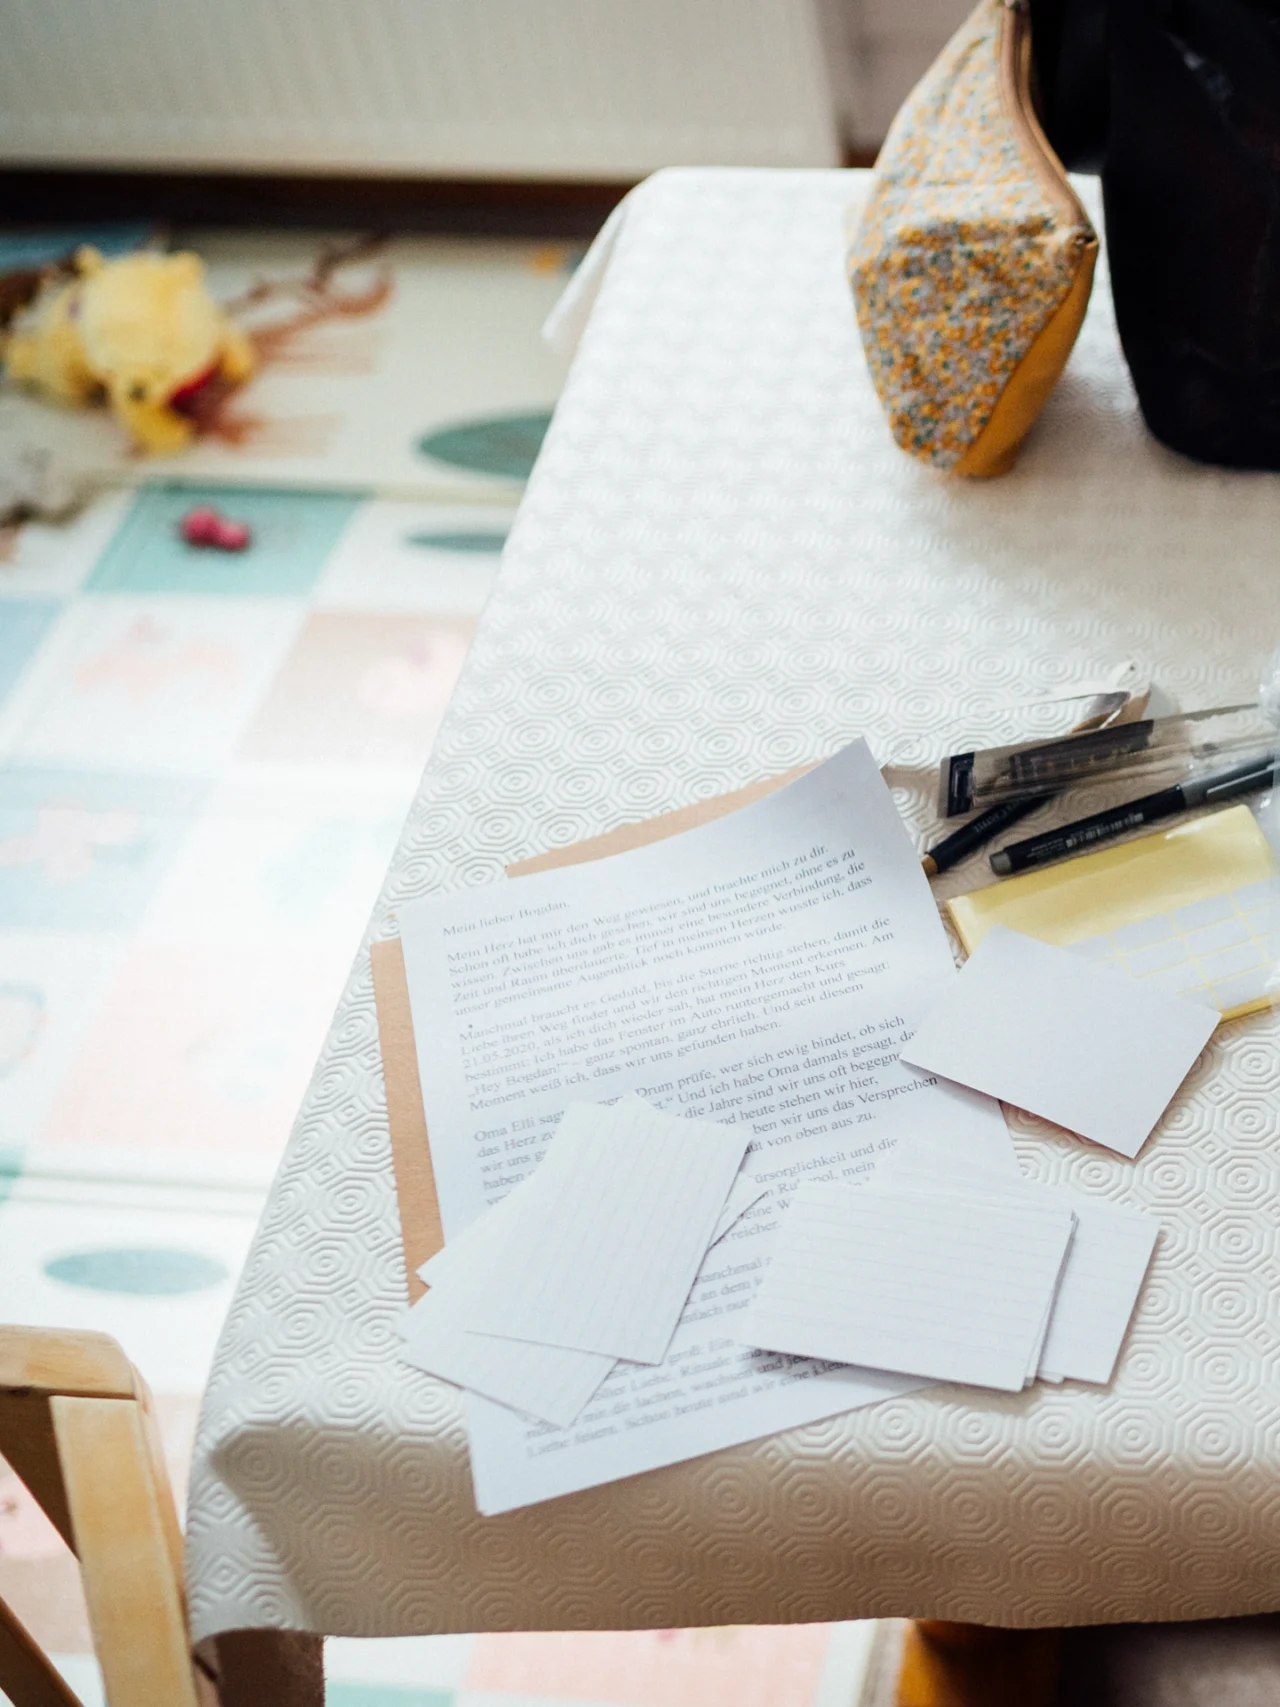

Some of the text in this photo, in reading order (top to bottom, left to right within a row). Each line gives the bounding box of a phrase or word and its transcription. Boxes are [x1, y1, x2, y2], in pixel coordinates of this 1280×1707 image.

[761, 860, 792, 878] mich
[793, 855, 809, 866] zu
[809, 847, 830, 859] dir.
[794, 865, 825, 881] ohne
[826, 858, 840, 868] es
[841, 850, 857, 862] zu
[773, 863, 867, 902] Verbindung, die
[822, 888, 845, 902] ich,
[846, 877, 874, 892] dass
[832, 924, 869, 942] damit
[870, 918, 892, 930] die
[870, 932, 896, 945] Am
[762, 1000, 792, 1016] Und
[793, 993, 817, 1008] seit
[818, 983, 865, 1001] diesem
[470, 1021, 783, 1112] Moment weiß ich, dass wir uns gefunden haben.
[474, 1126, 508, 1143] Oma
[511, 1116, 536, 1133] Elli
[634, 1081, 674, 1098] Drum
[677, 1070, 718, 1090] prüfe,
[719, 1061, 746, 1075] wer
[746, 1050, 775, 1068] sich
[776, 1043, 811, 1059] ewig
[811, 1029, 857, 1049] bindet,
[858, 1022, 877, 1036] ob
[878, 1014, 906, 1031] sich
[477, 1145, 501, 1159] das
[504, 1135, 538, 1151] Herz
[677, 1086, 708, 1104] Und
[708, 1080, 731, 1095] ich
[732, 1072, 766, 1088] habe
[766, 1063, 801, 1079] Oma
[801, 1049, 849, 1069] damals
[851, 1034, 898, 1058] gesagt,
[781, 1112, 805, 1127] wir
[806, 1106, 830, 1120] uns
[831, 1099, 856, 1112] das
[856, 1076, 939, 1105] Versprechen
[481, 1158, 503, 1174] wir
[507, 1152, 531, 1167] uns
[683, 1106, 706, 1119] die
[707, 1095, 745, 1113] Jahre
[746, 1084, 775, 1102] sind
[778, 1078, 801, 1093] wir
[802, 1072, 827, 1086] uns
[828, 1064, 848, 1079] oft
[483, 1076, 880, 1191] haben nd heute stehen wir hier,
[767, 1134, 793, 1148] von
[795, 1123, 828, 1140] oben
[830, 1116, 854, 1130] aus
[855, 1110, 876, 1122] zu.
[755, 1148, 847, 1185] ürsorglichkeit
[849, 1140, 875, 1158] und
[843, 1161, 876, 1177] mein
